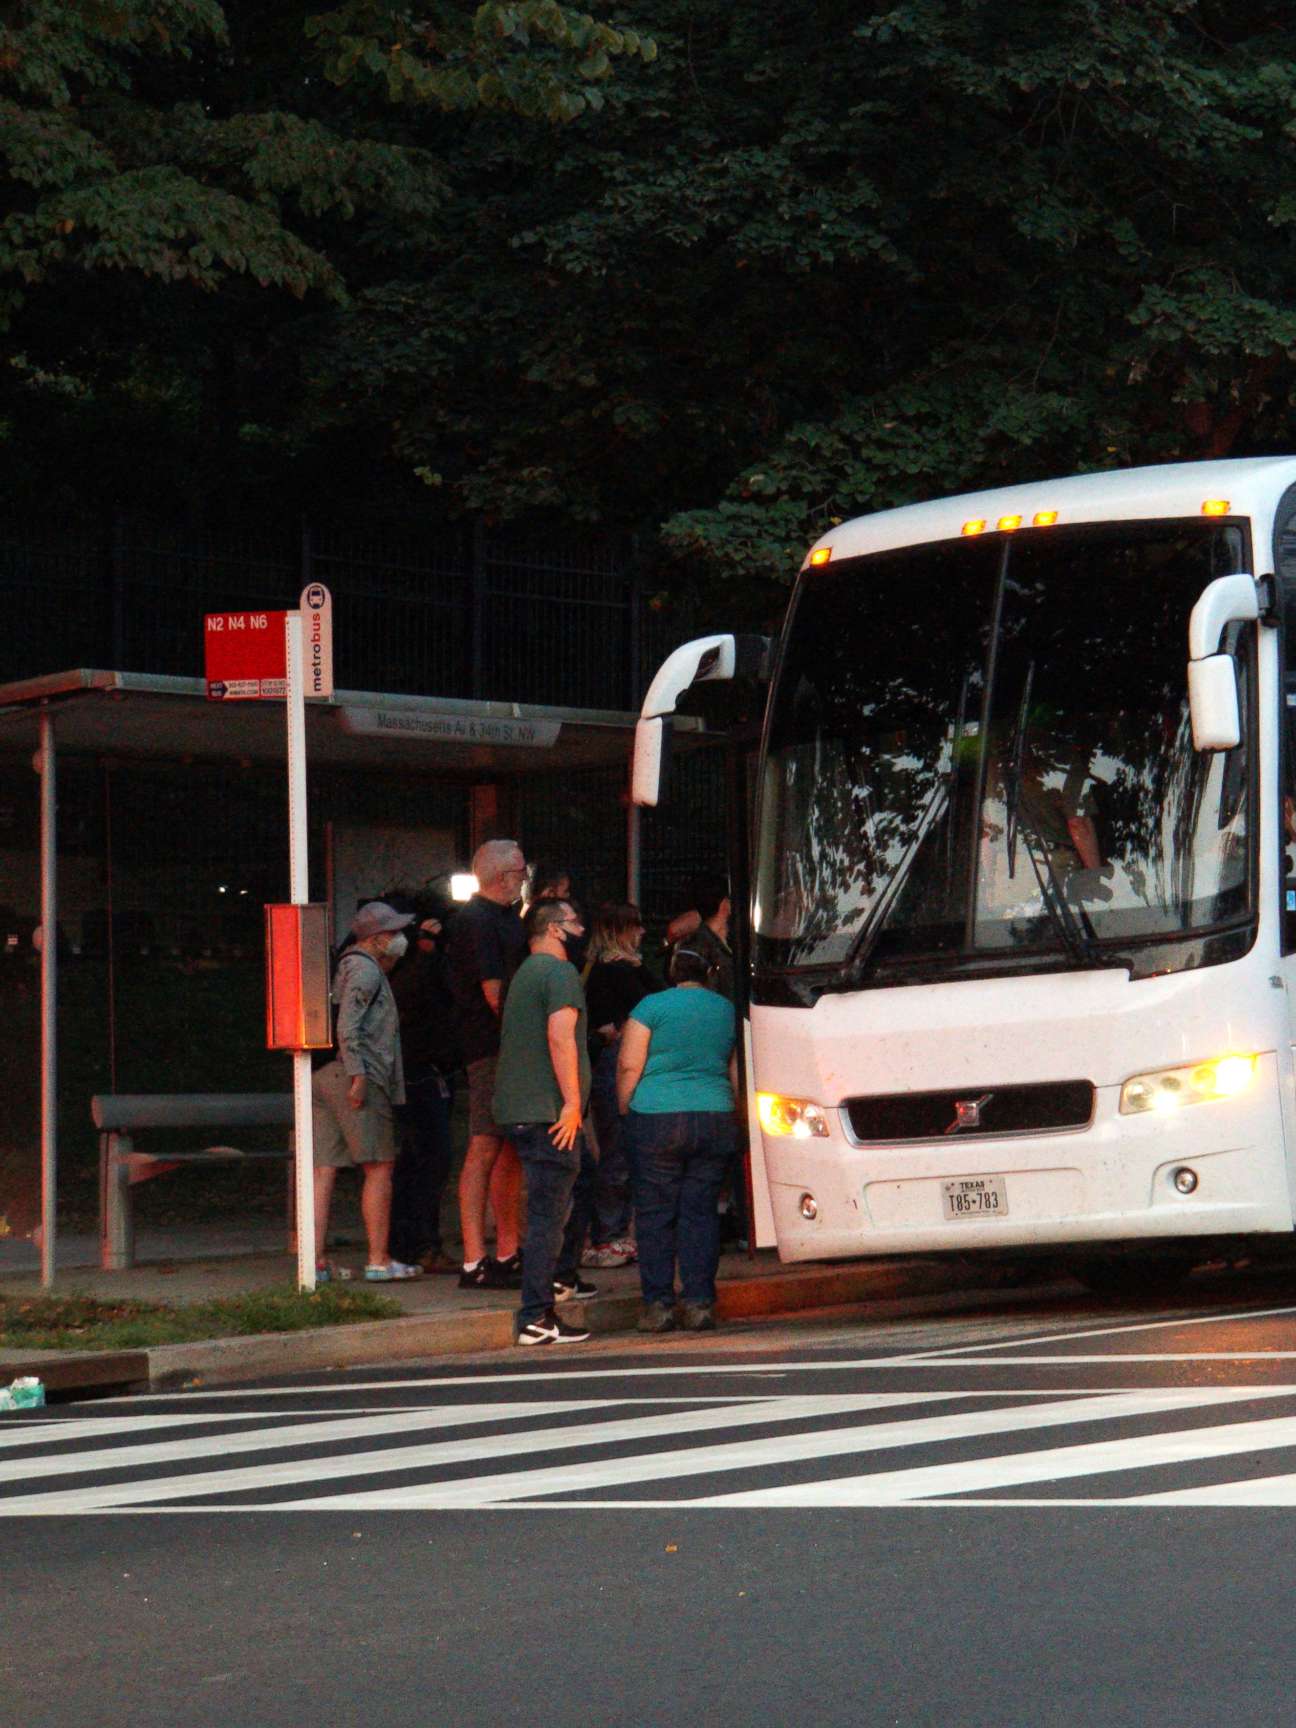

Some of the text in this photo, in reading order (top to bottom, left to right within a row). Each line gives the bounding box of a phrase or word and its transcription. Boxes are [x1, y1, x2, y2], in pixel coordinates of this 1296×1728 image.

[207, 614, 268, 631] N2 N4 N6
[310, 612, 322, 692] metrobus
[960, 1181, 985, 1190] TEXAS
